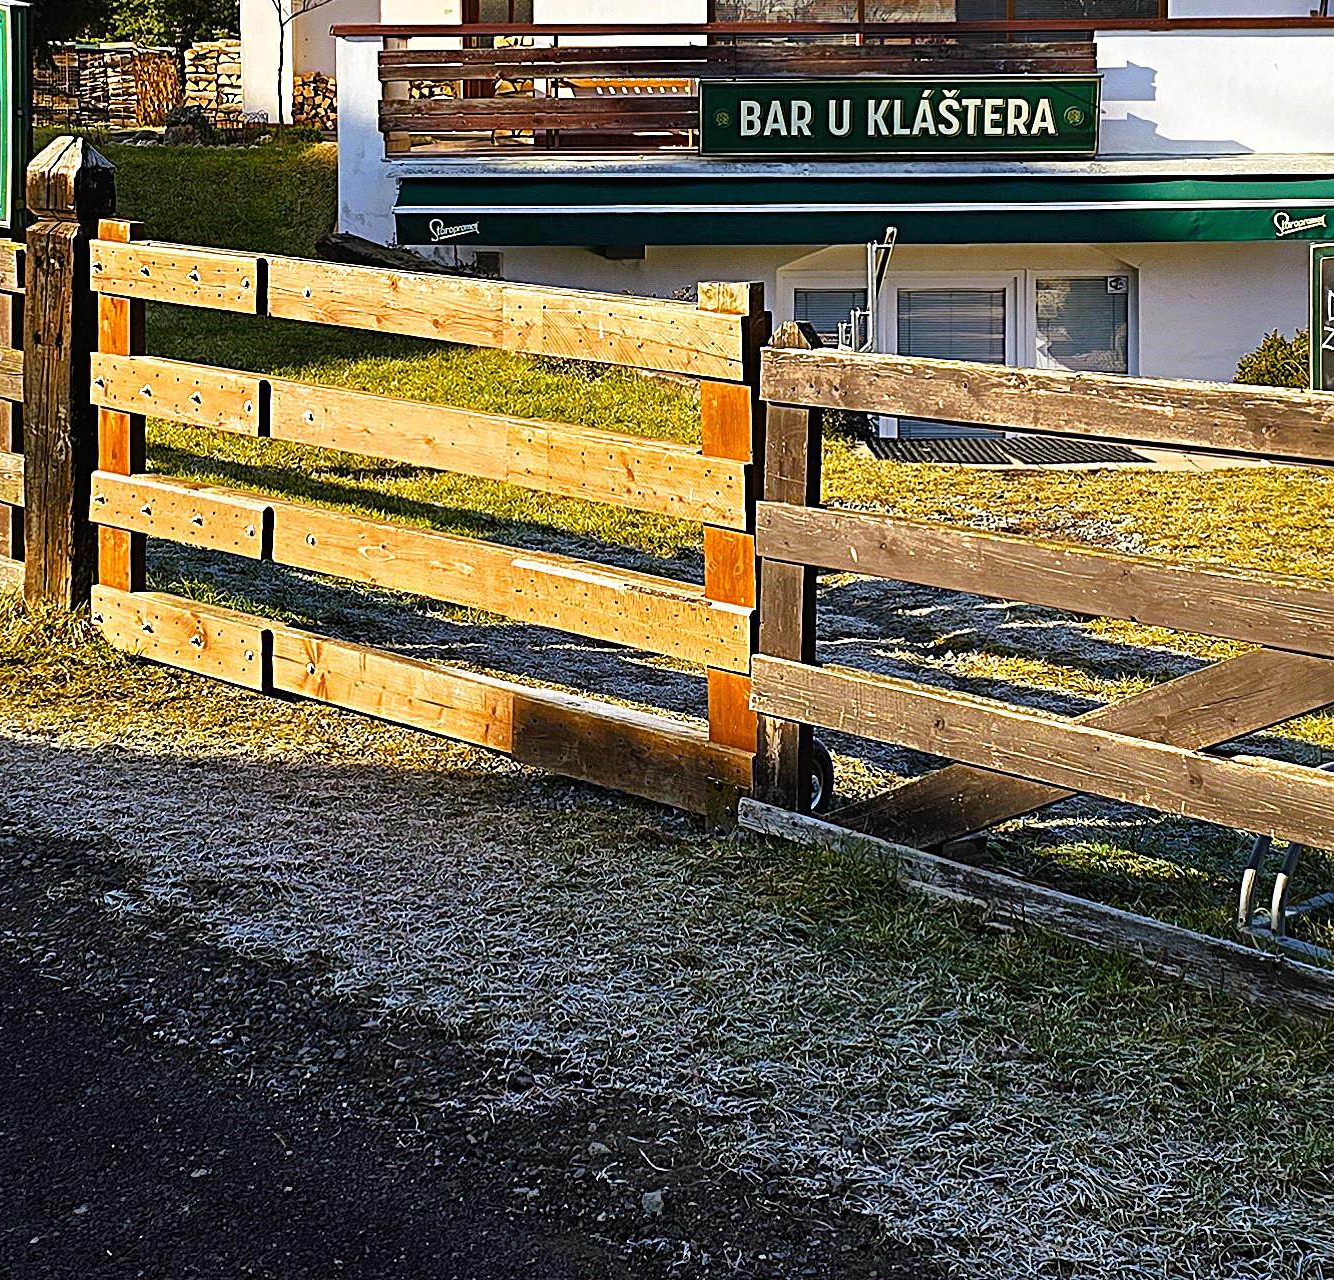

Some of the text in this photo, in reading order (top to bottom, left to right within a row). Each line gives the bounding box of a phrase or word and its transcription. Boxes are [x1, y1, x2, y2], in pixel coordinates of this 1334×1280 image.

[740, 89, 1059, 137] BAR U KLÁŠTERA
